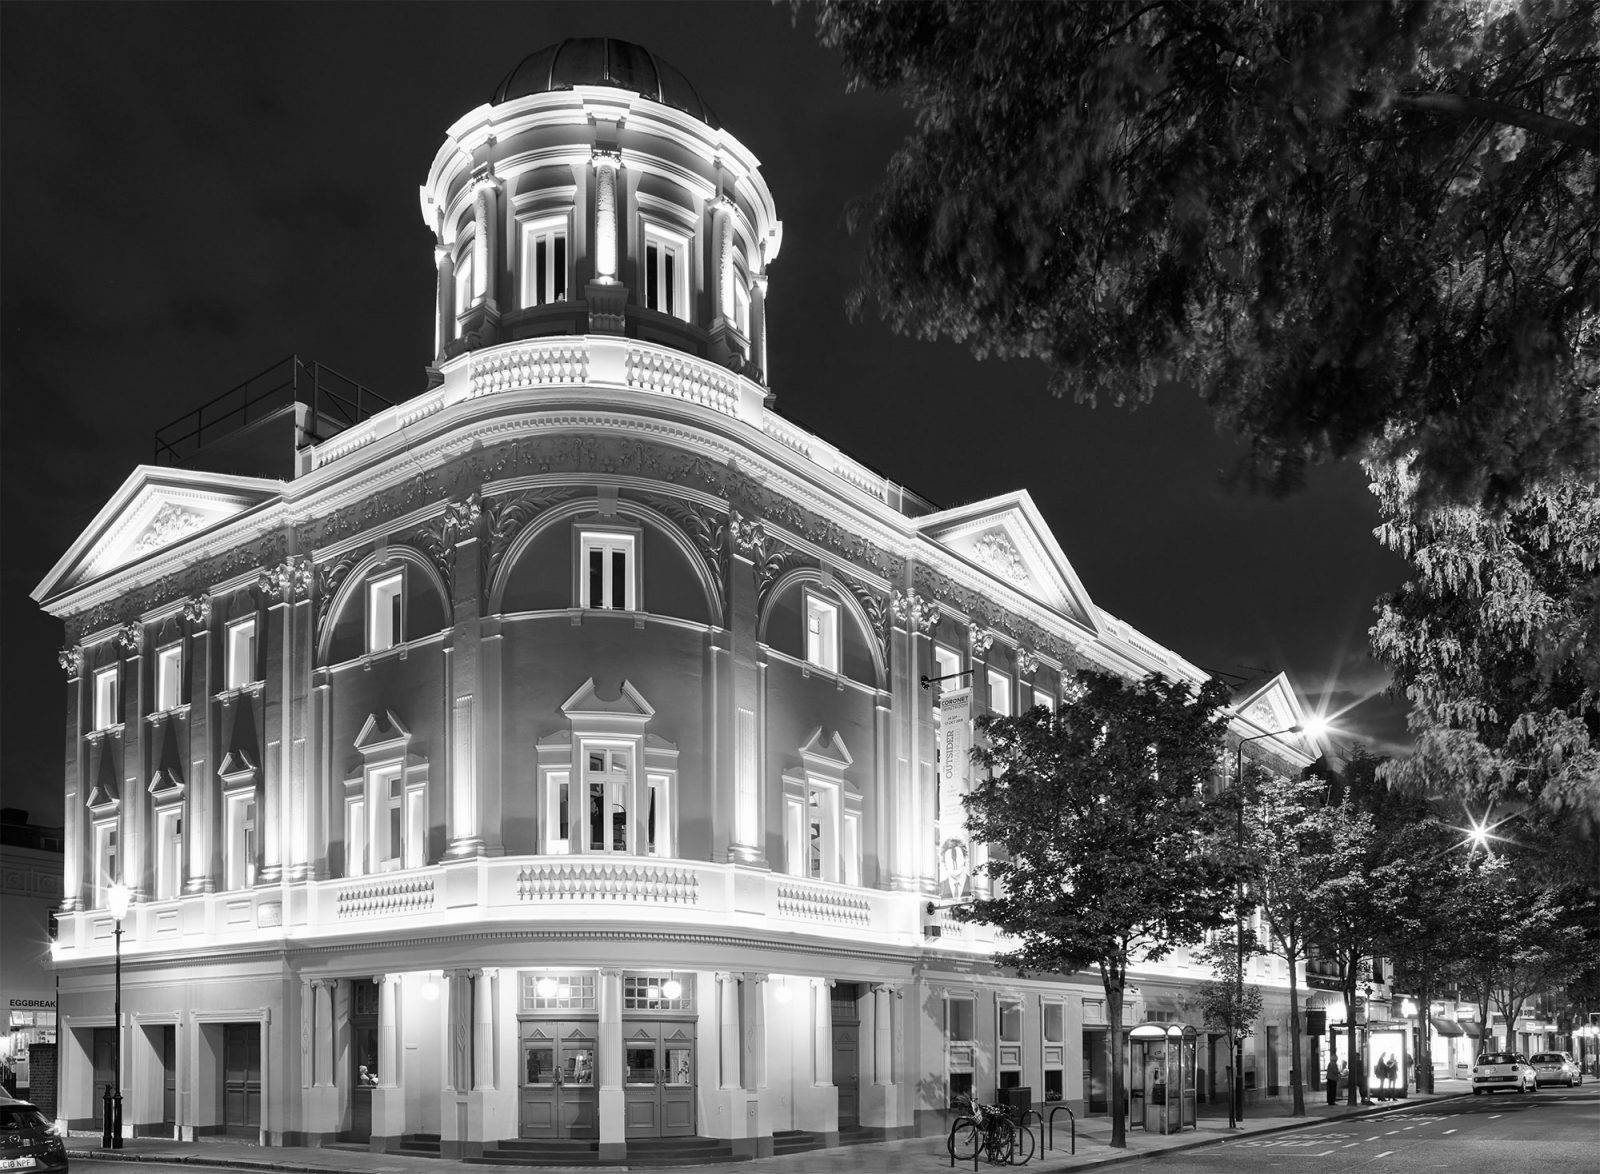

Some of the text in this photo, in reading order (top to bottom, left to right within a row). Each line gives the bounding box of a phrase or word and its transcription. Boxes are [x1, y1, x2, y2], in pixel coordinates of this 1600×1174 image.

[942, 695, 968, 706] CORONET
[945, 730, 954, 779] OUTSIDER
[0, 1160, 15, 1168] C18
